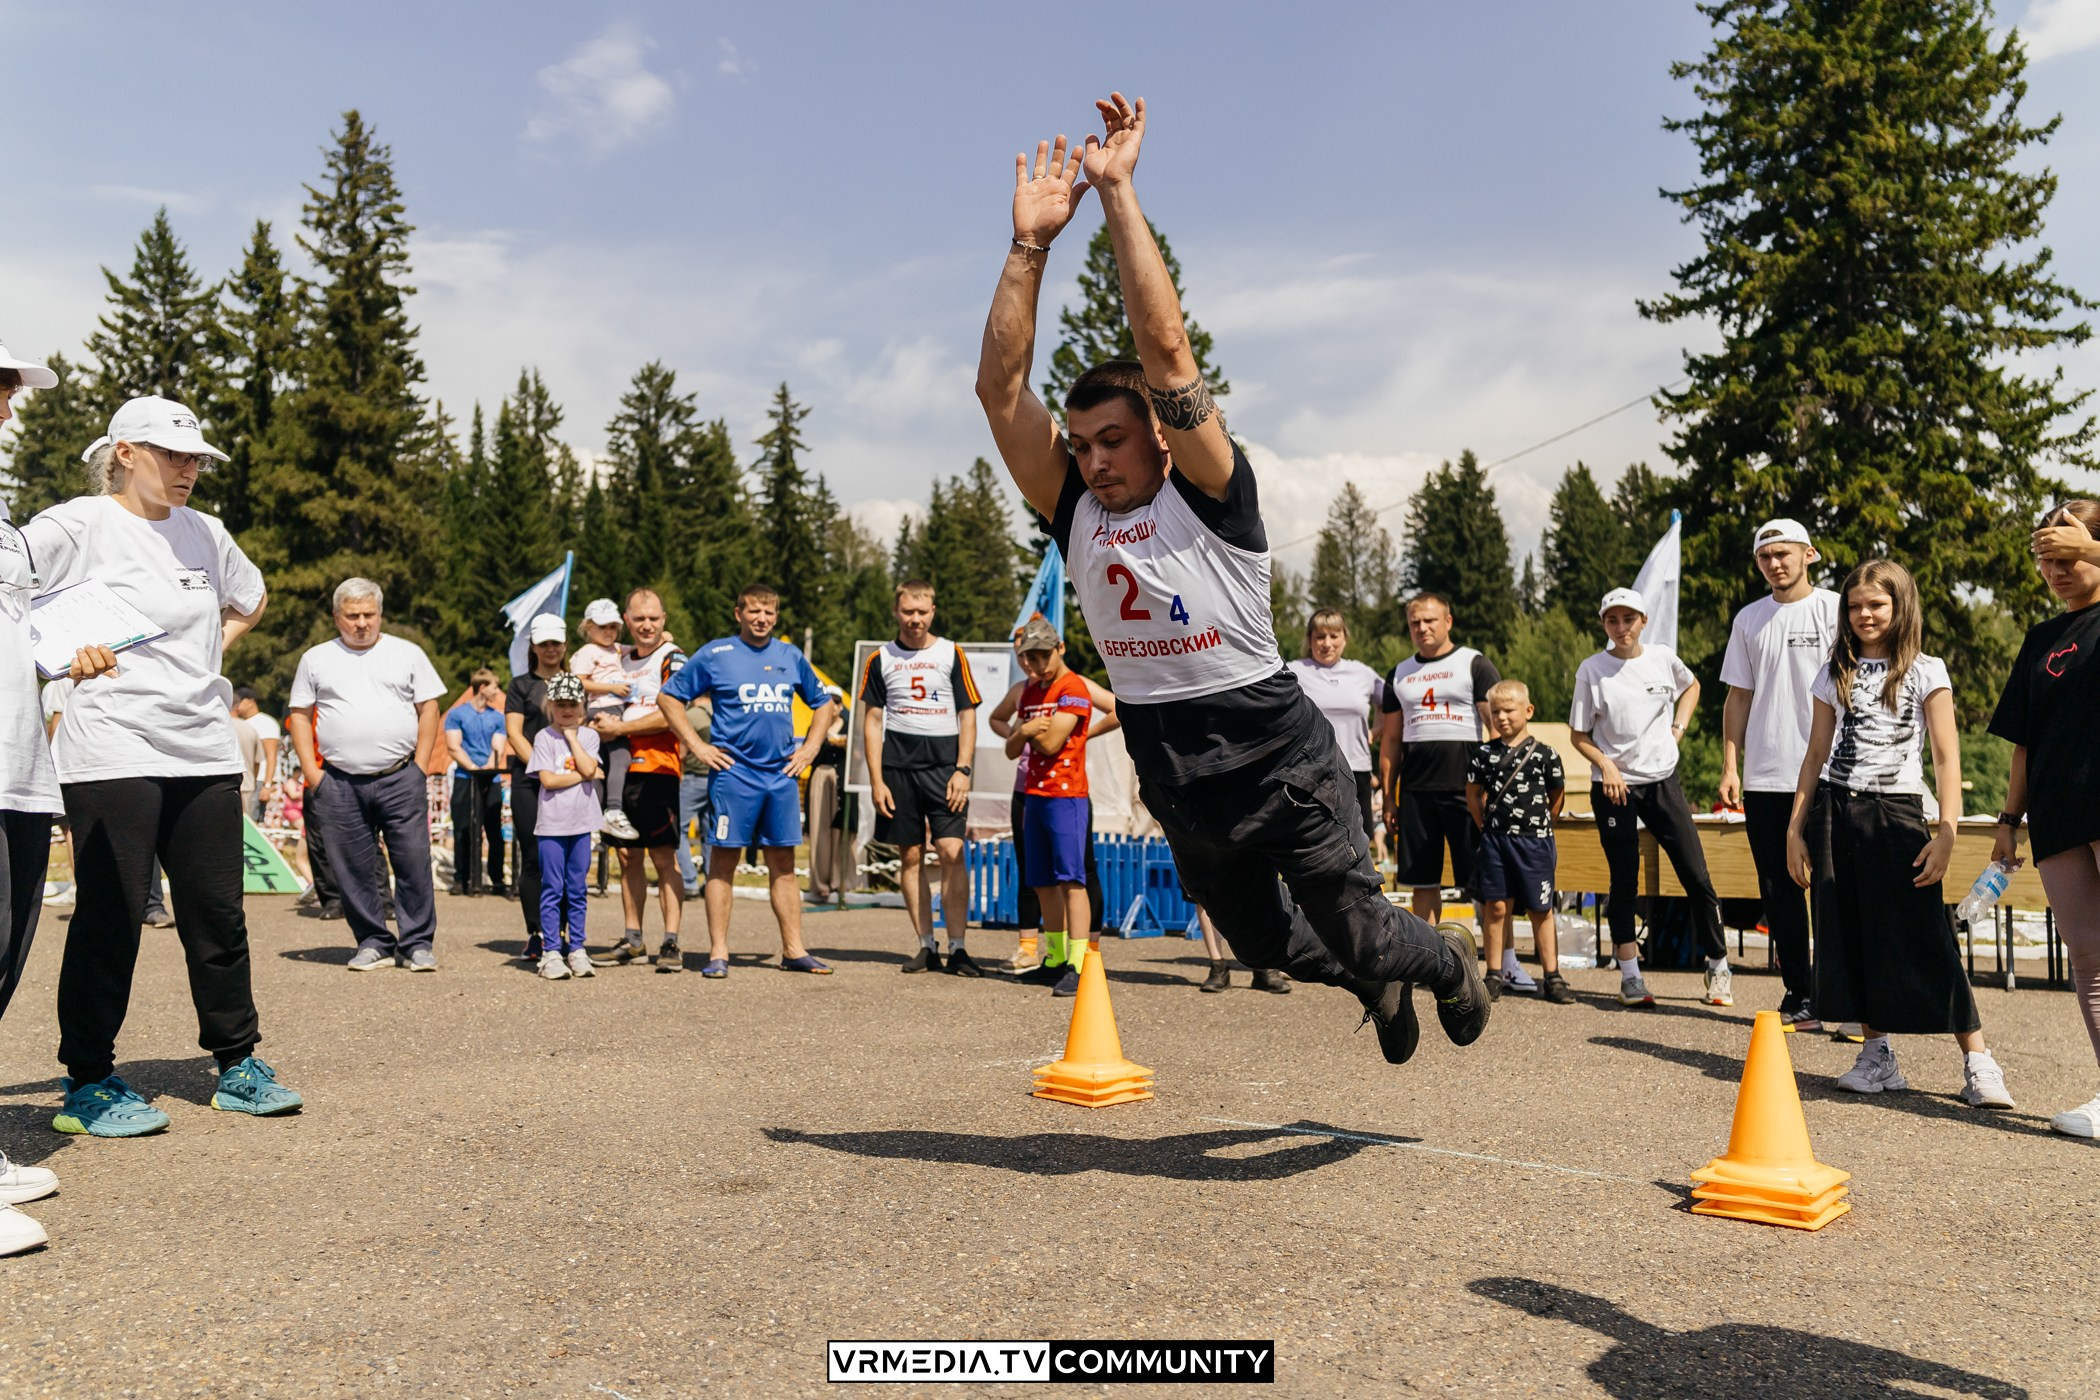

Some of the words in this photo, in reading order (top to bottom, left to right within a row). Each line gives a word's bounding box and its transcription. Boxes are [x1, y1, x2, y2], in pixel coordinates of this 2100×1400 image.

[1106, 563, 1152, 621] 2
[1169, 594, 1190, 626] 4
[1105, 625, 1222, 657] БЕРЁЗОВСКИЙ
[911, 676, 926, 701] 5
[931, 690, 939, 702] 4
[1421, 687, 1437, 711] 4
[742, 702, 790, 714] УГОЛЬ
